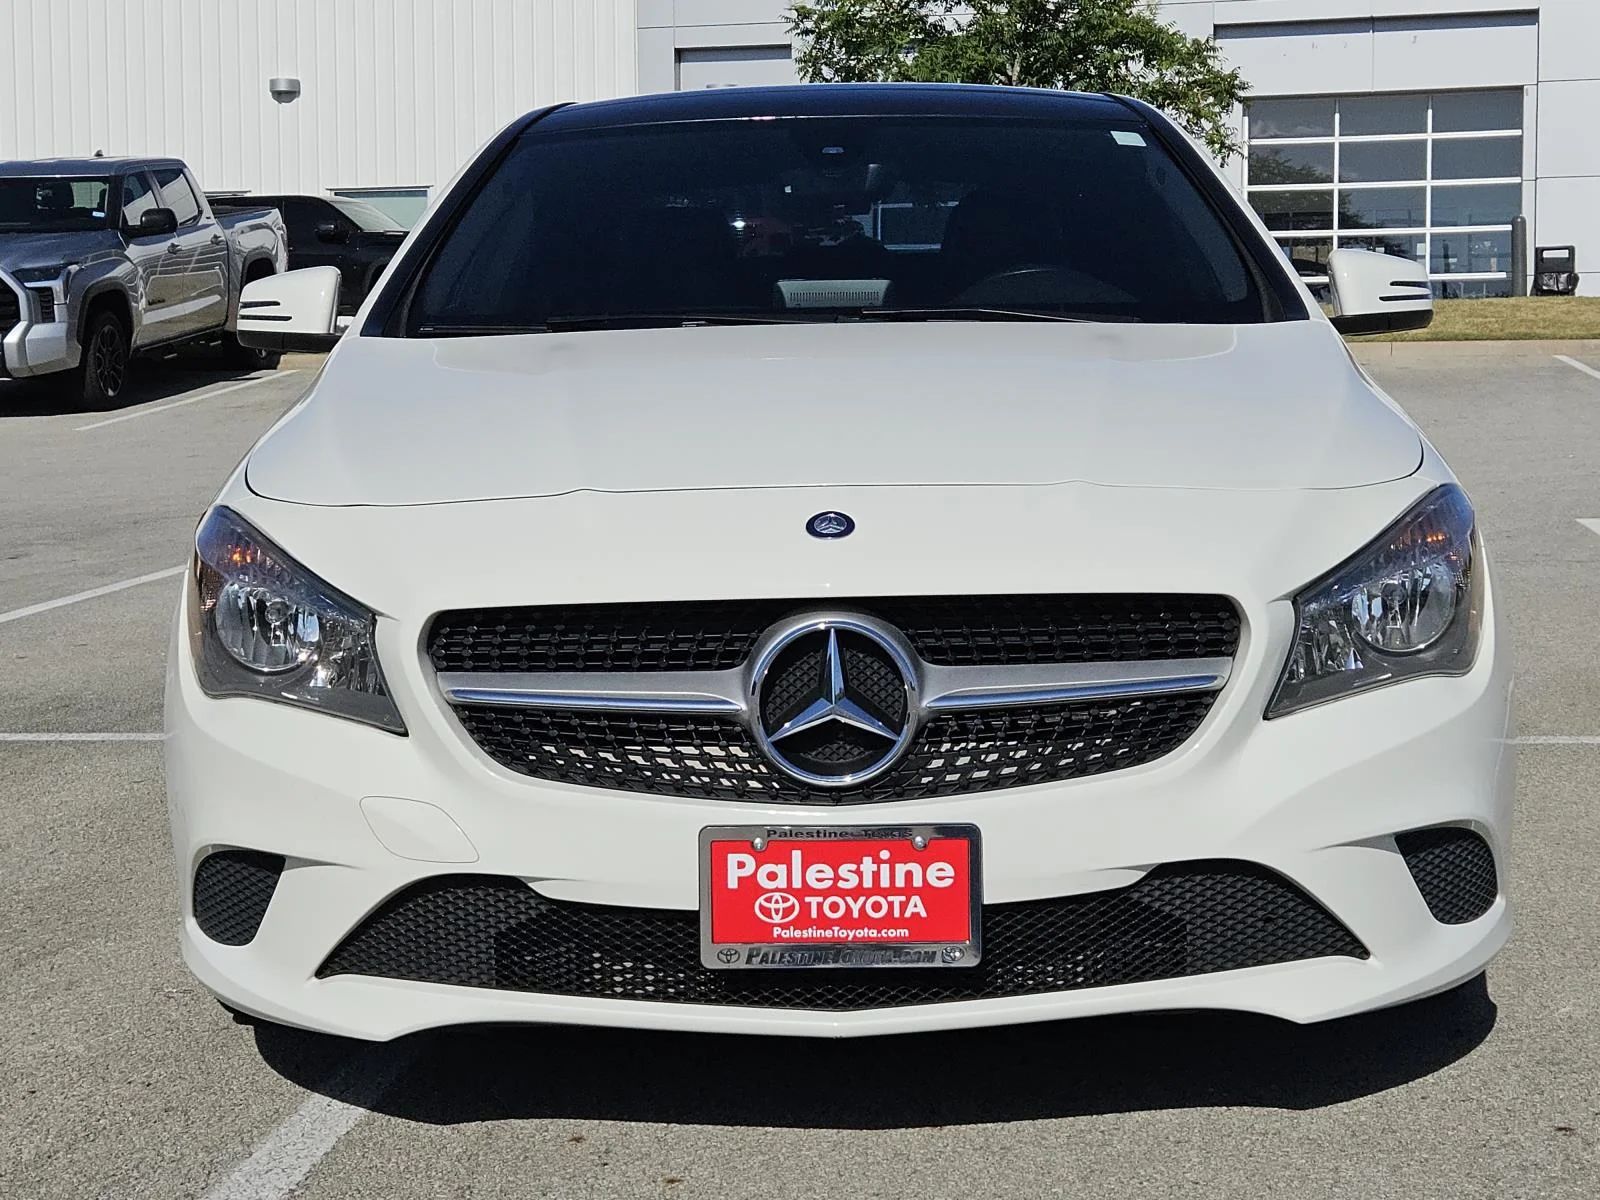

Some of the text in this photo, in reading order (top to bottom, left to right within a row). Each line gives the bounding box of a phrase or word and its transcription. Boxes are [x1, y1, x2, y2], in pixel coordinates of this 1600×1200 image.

[727, 850, 955, 889] Palestine
[805, 895, 927, 919] TOYOTA
[773, 926, 909, 940] PalestineToyota.com
